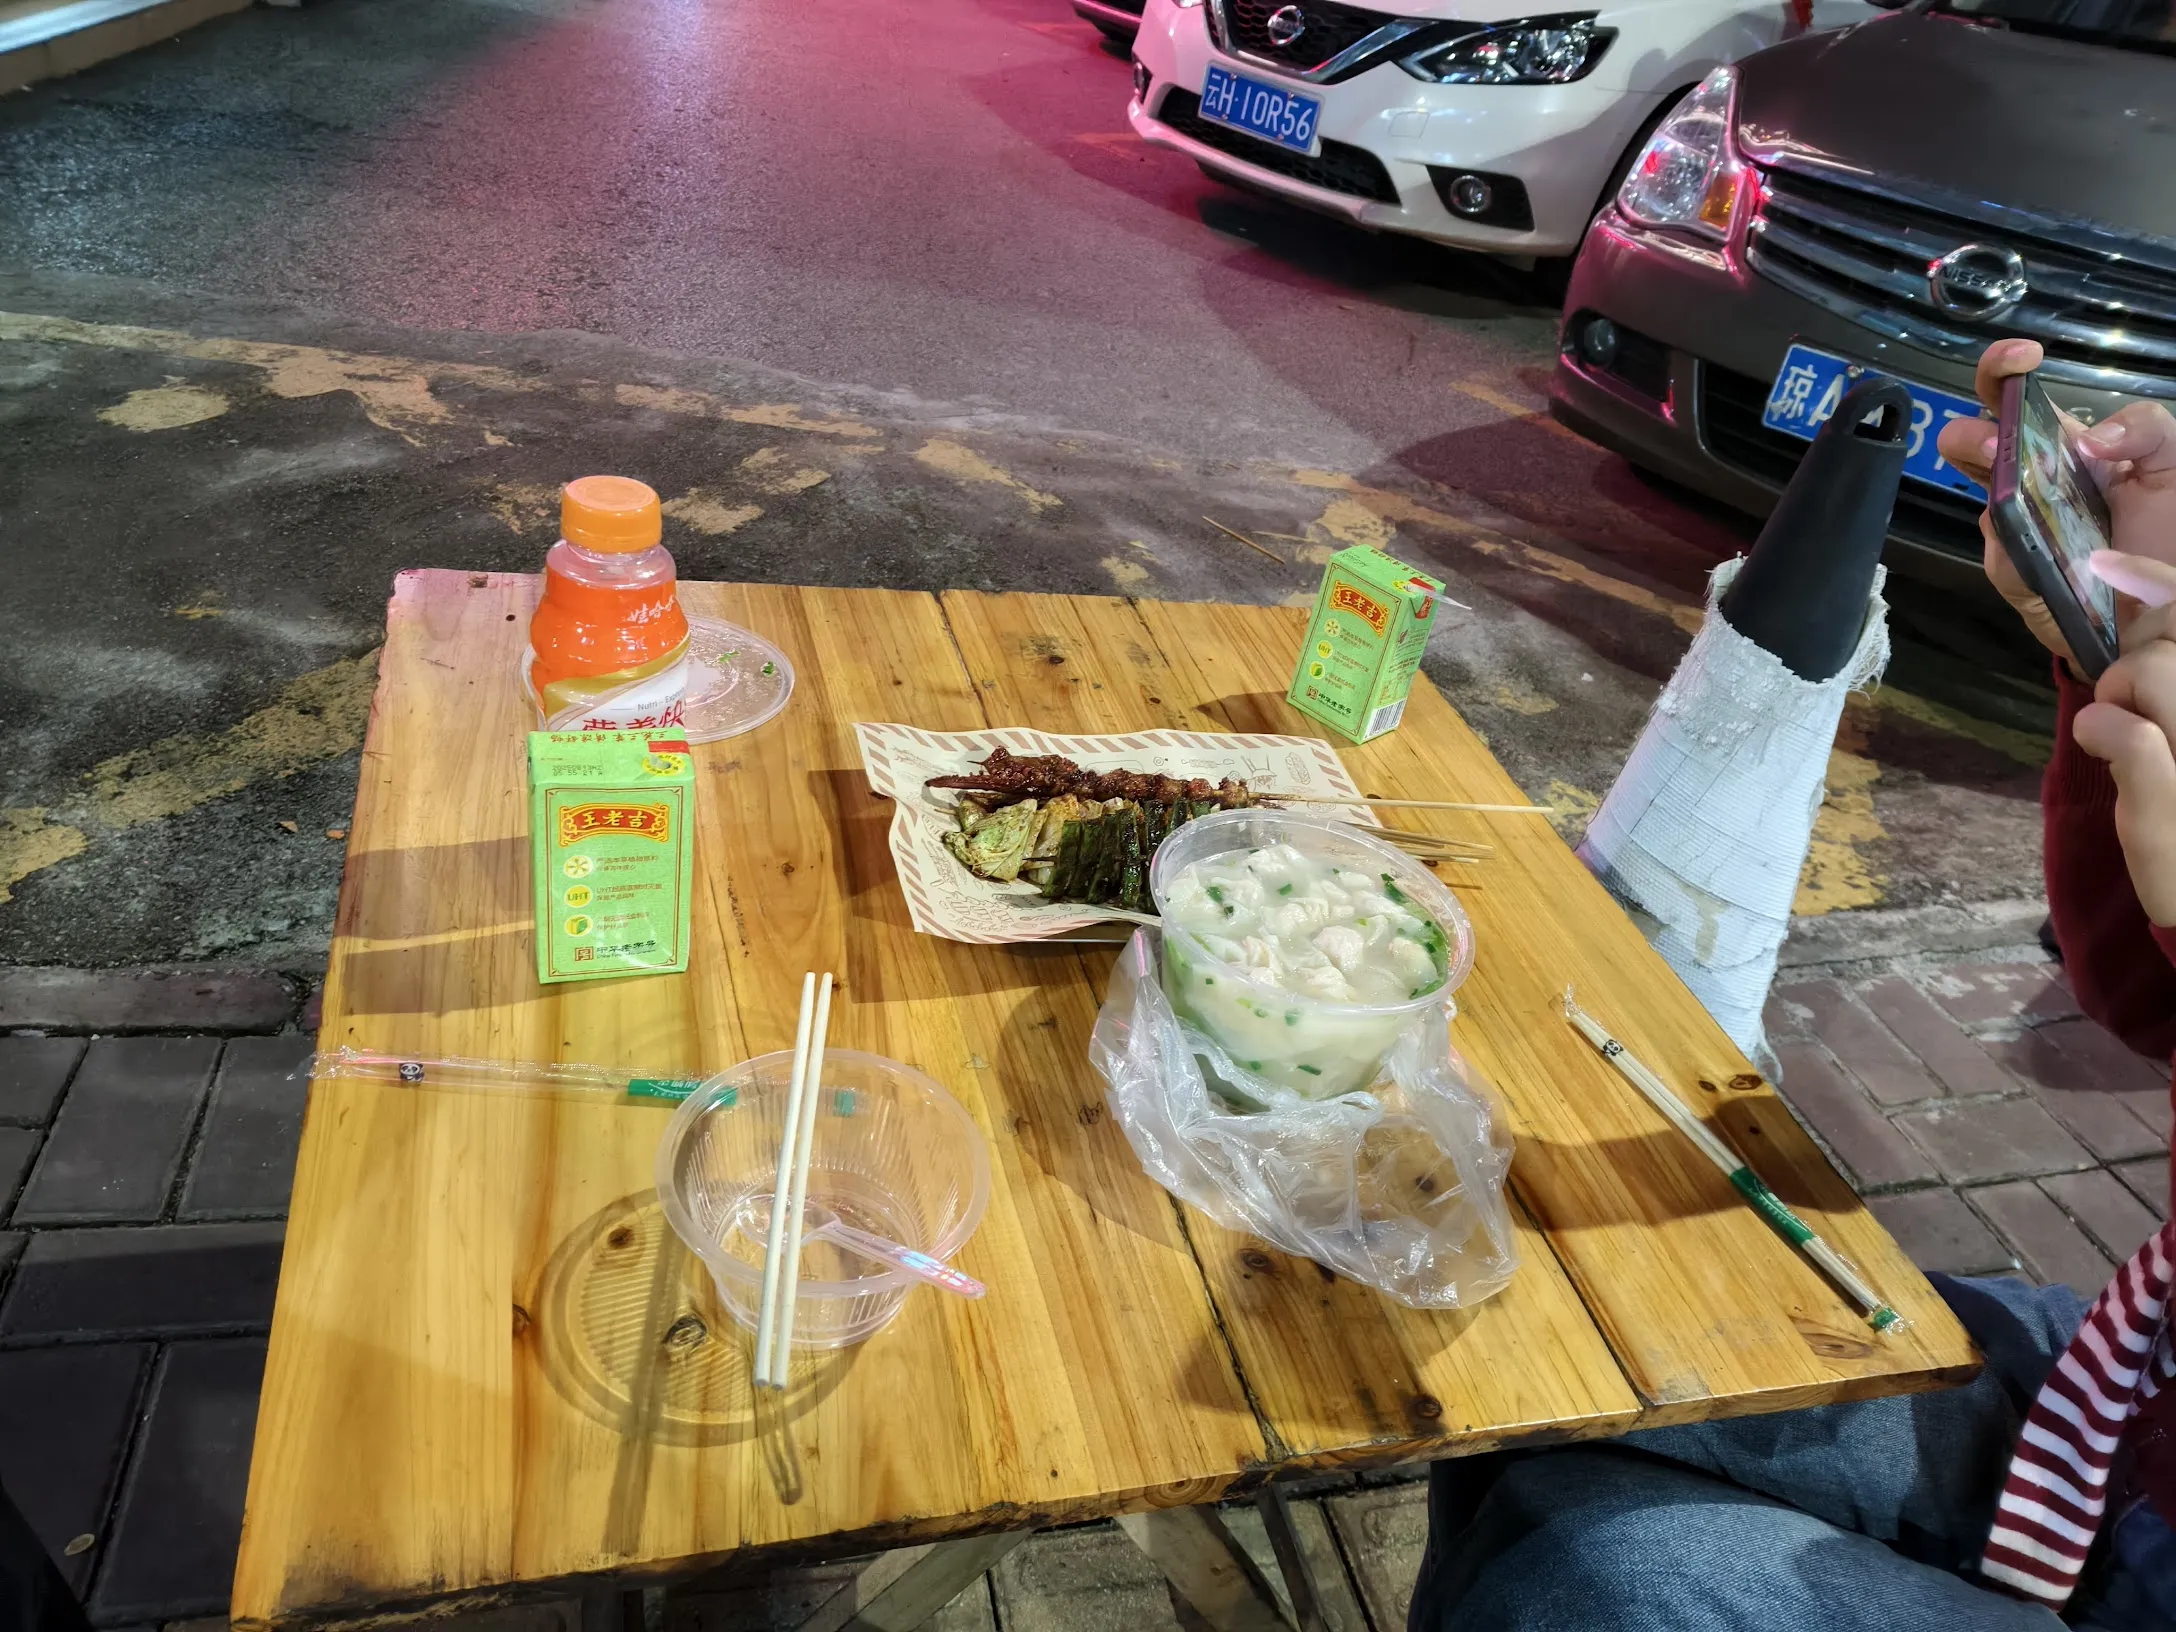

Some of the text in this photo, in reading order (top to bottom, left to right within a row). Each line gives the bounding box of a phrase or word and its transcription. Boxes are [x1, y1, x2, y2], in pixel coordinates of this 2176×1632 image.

[1343, 592, 1378, 618] 王老吉
[580, 810, 649, 828] 王老吉
[567, 891, 590, 901] UHT
